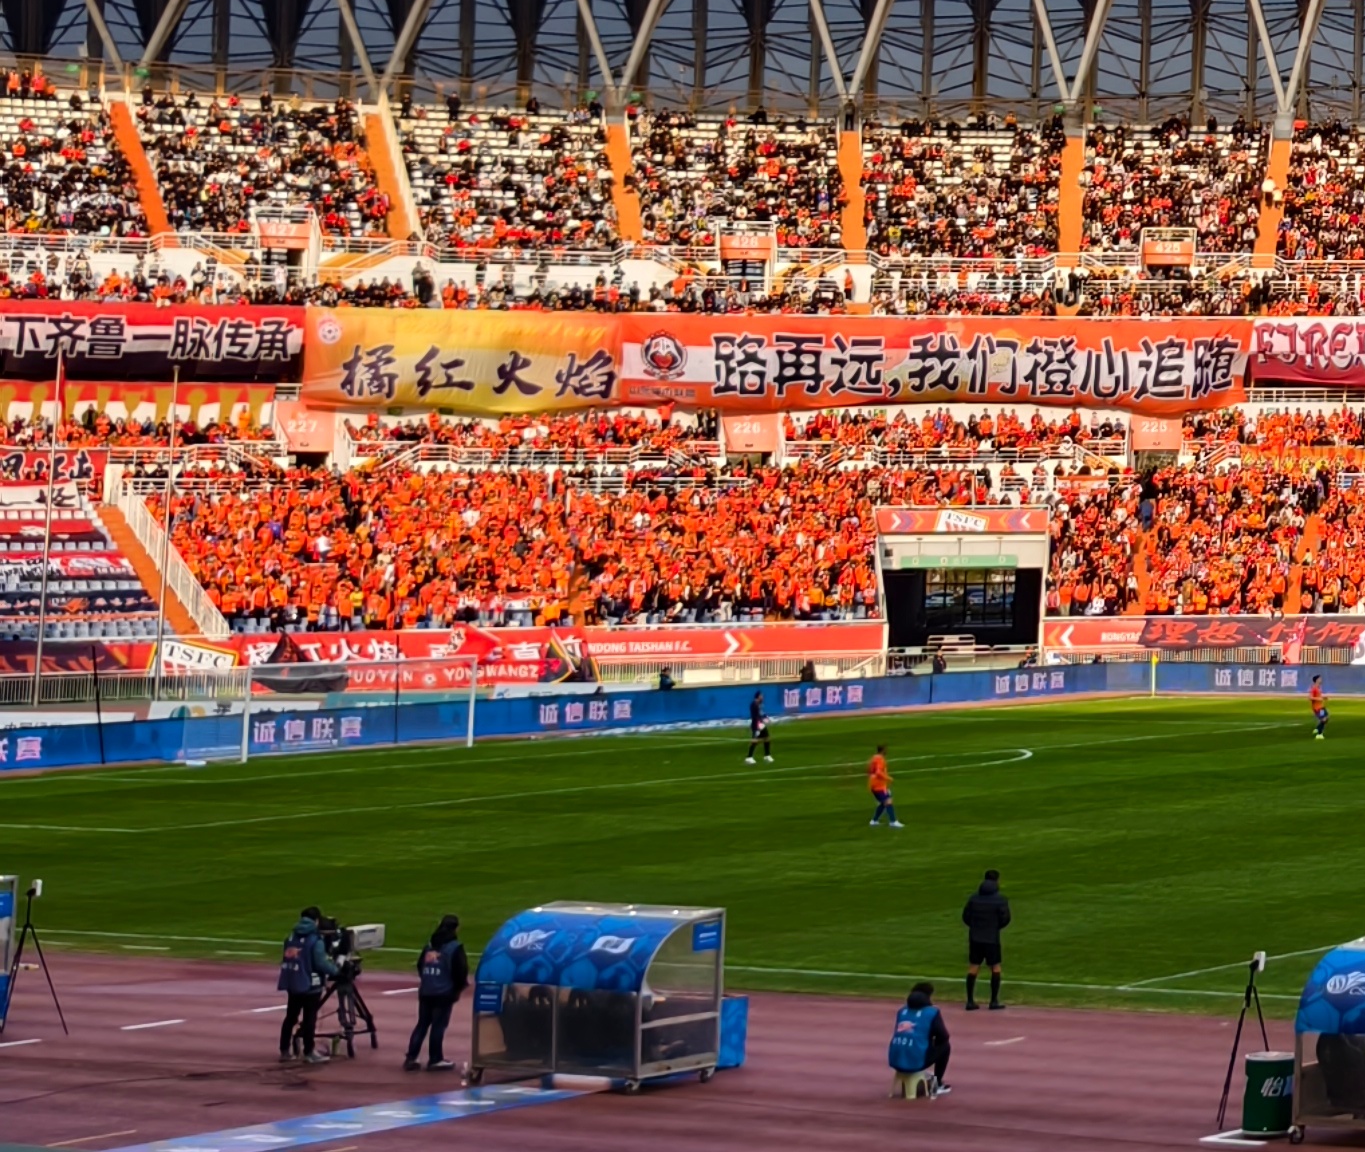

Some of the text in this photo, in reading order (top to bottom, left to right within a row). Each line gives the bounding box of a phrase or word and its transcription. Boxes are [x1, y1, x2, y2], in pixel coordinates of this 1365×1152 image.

[0, 314, 294, 362] 下齐鲁一脉传承
[339, 344, 618, 399] 橘红火焰
[287, 420, 318, 433] 227
[164, 641, 228, 669] TSFC
